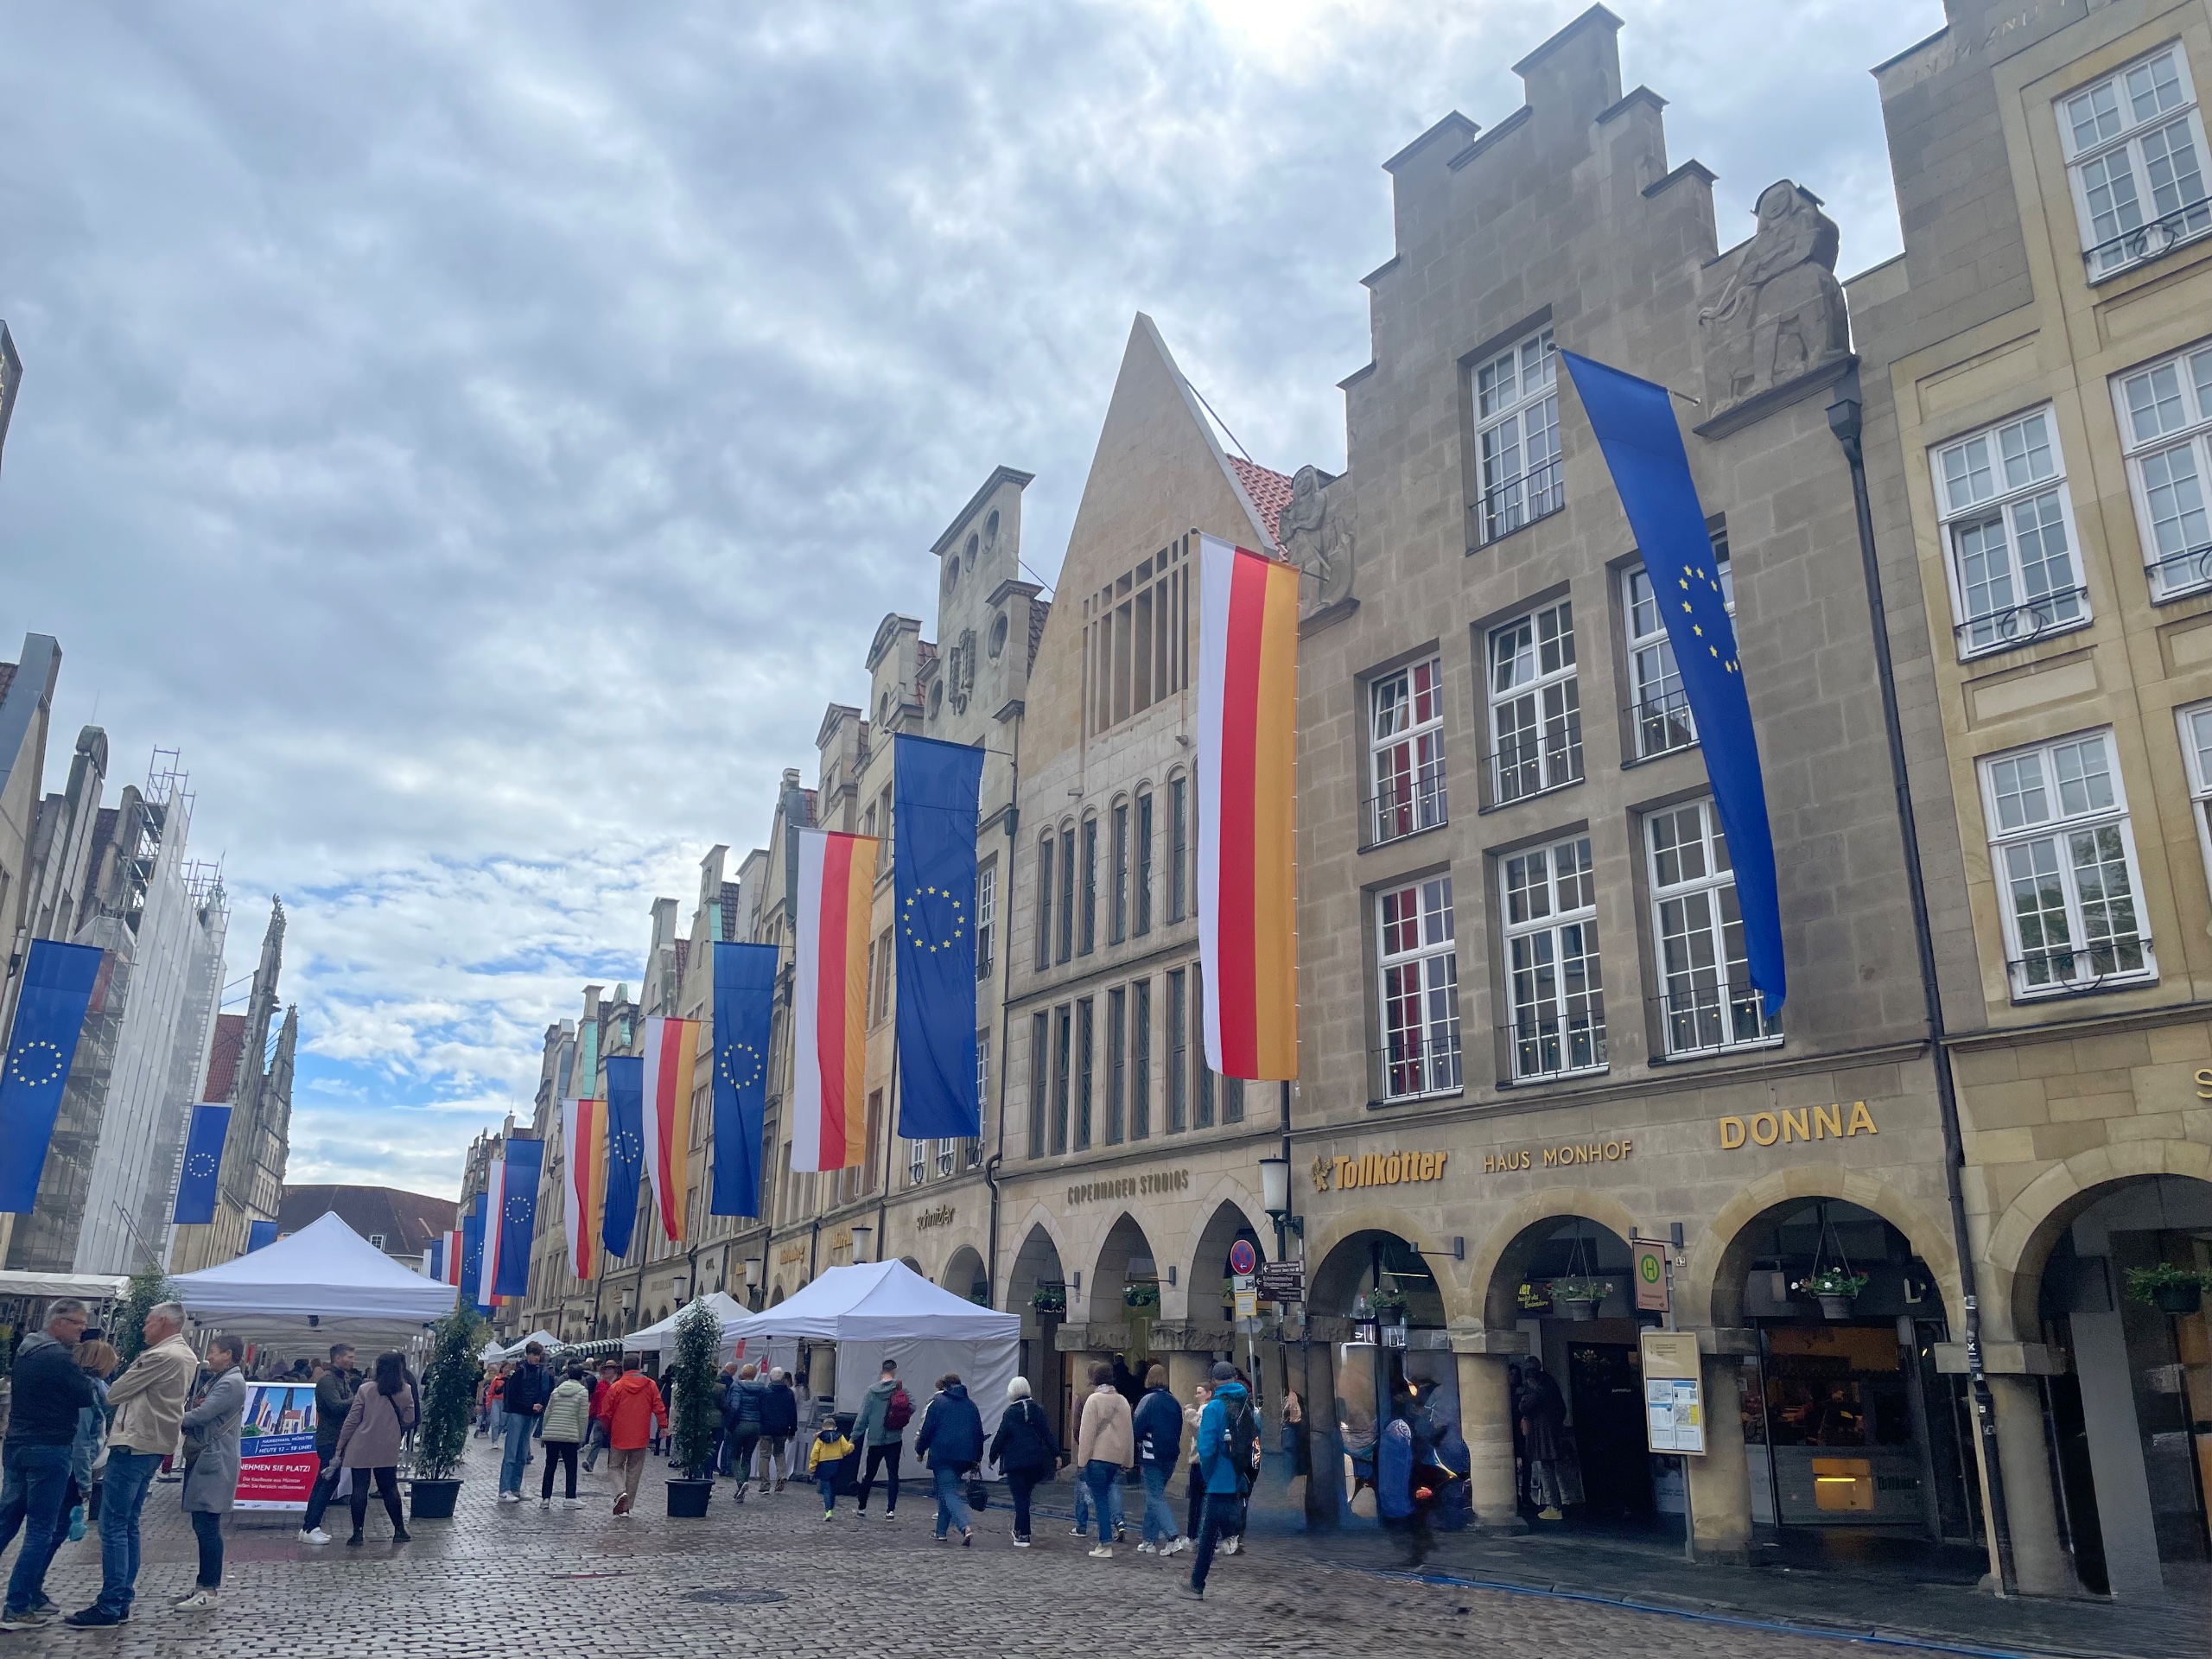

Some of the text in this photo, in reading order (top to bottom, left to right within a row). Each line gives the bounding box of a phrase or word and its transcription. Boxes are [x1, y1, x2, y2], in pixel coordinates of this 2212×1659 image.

[1719, 1101, 1878, 1149] DONNA
[1334, 1149, 1447, 1190] Tollkötter
[1483, 1140, 1631, 1173] HAUS MONHOF
[1067, 1169, 1189, 1205] COPENHAGEN STUDIOS
